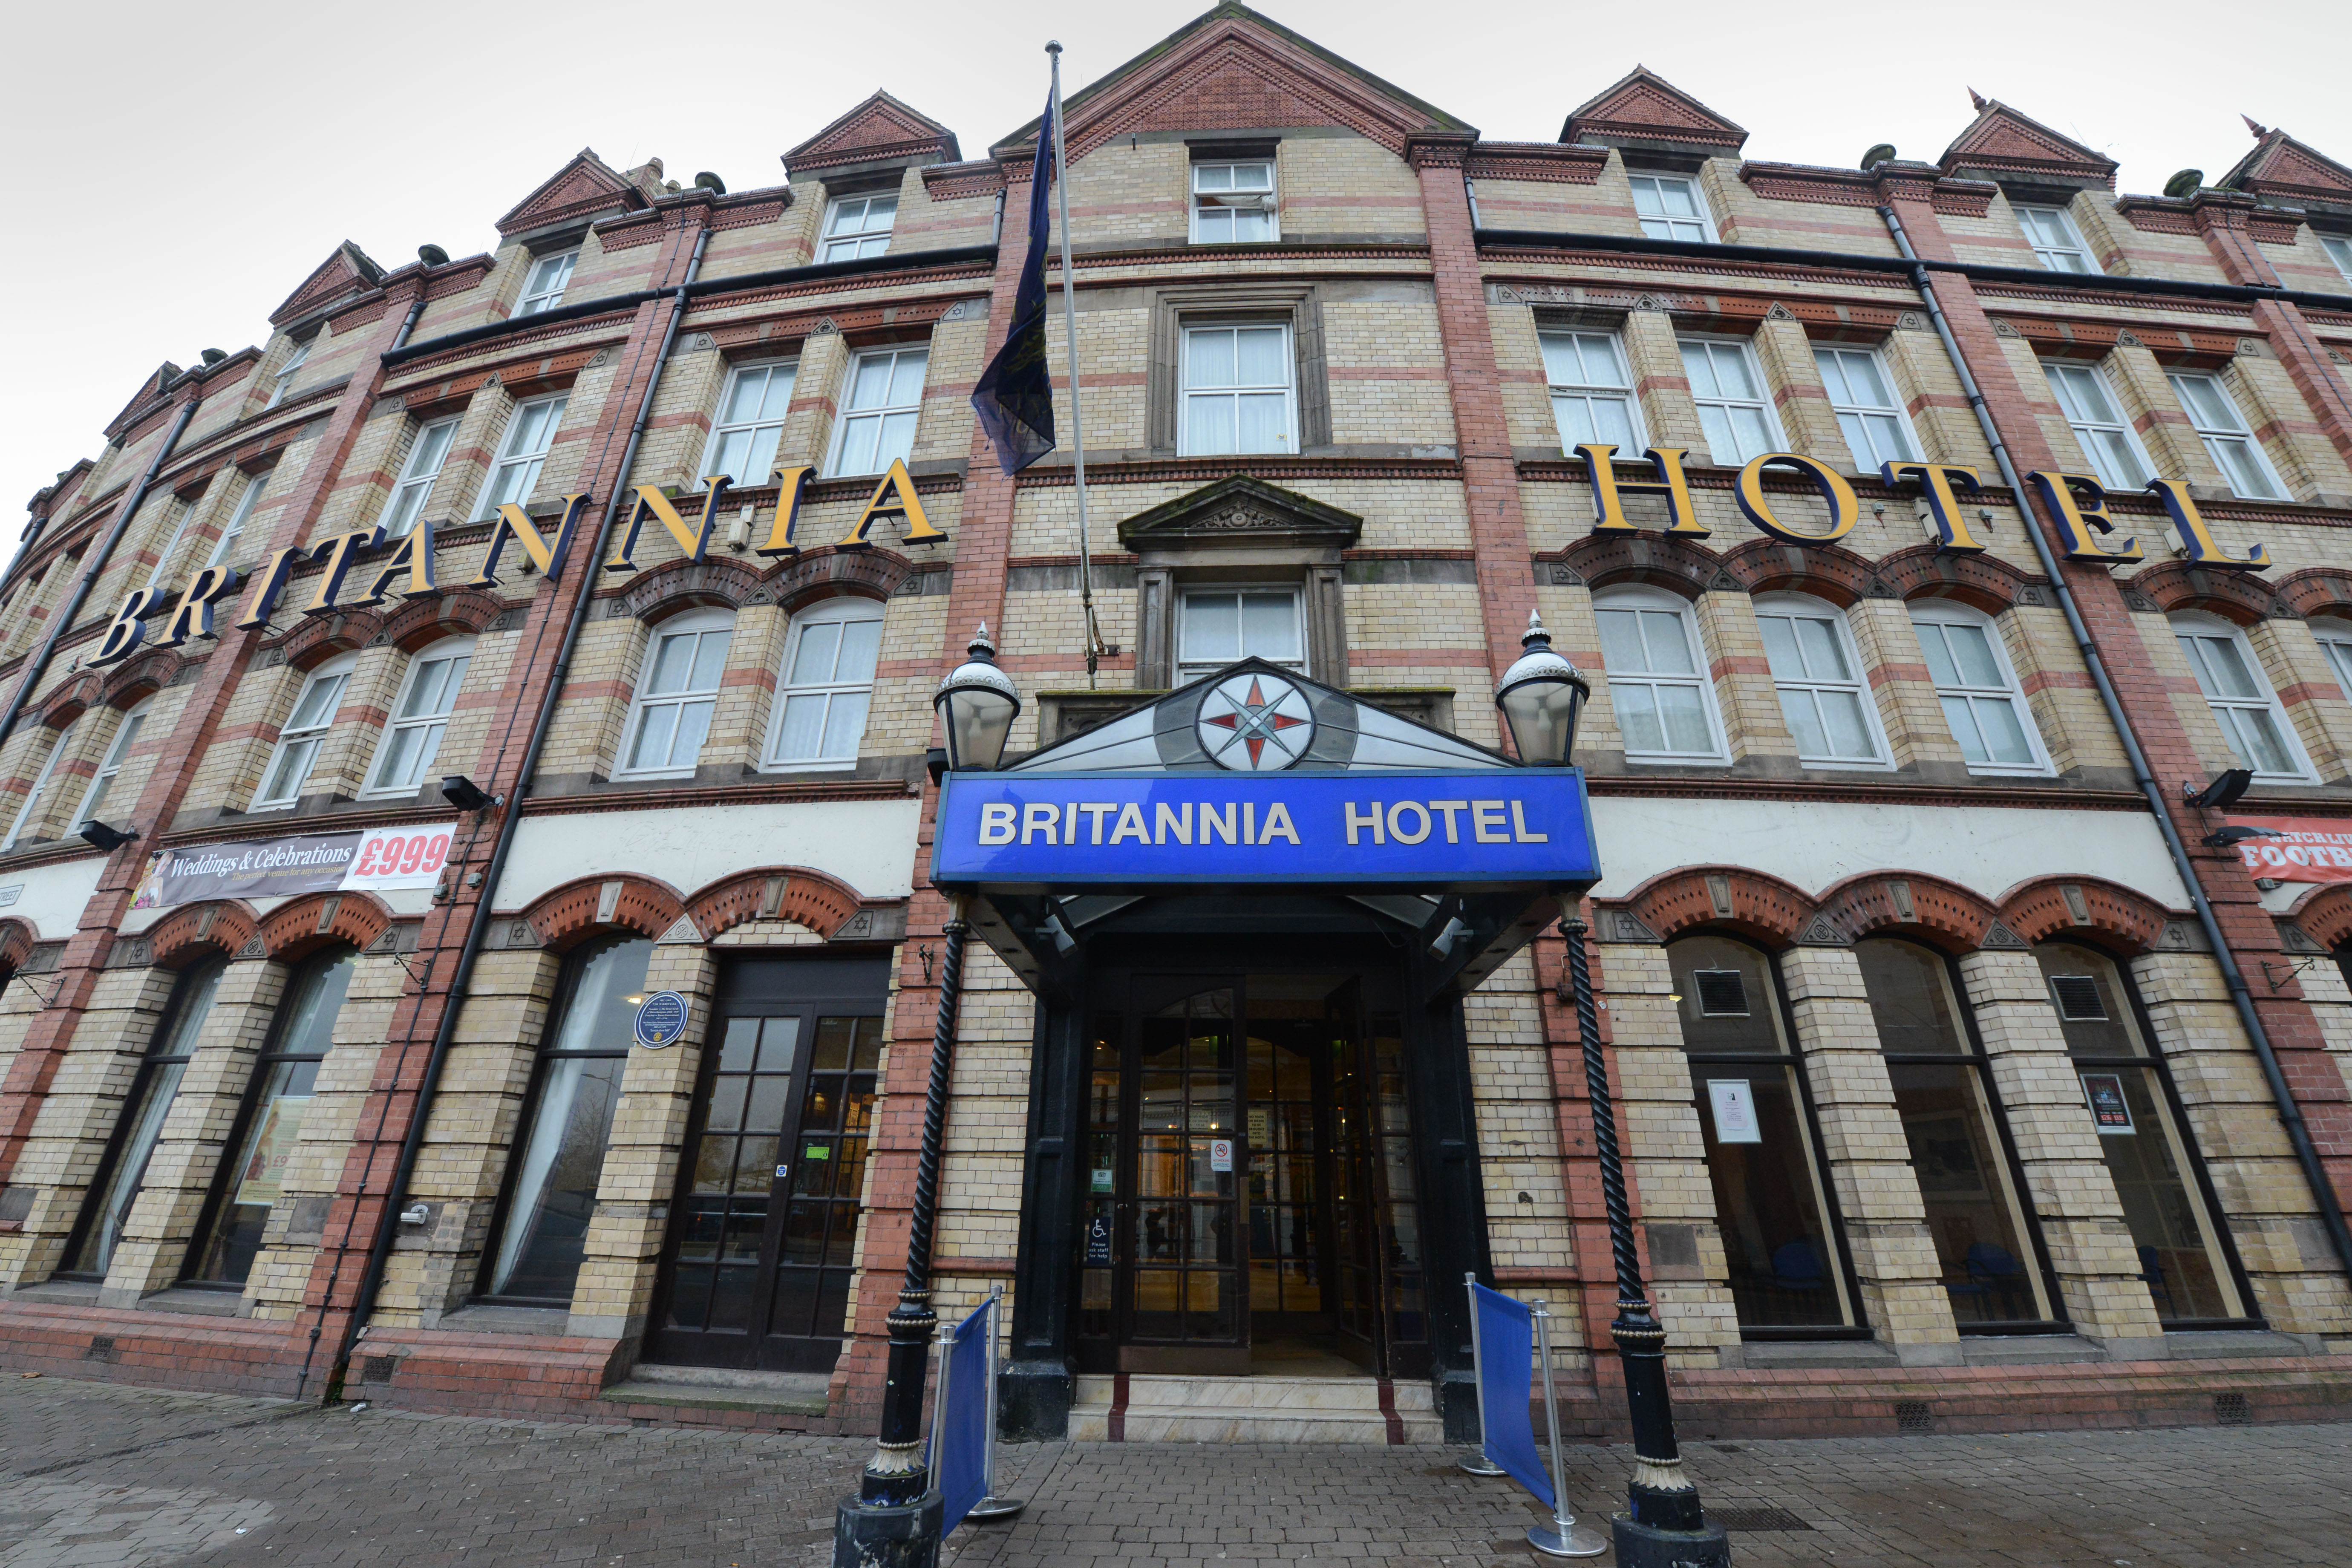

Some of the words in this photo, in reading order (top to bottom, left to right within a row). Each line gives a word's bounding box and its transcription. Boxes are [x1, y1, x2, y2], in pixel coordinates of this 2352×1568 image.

[84, 457, 948, 669] BRITANNIA
[1573, 444, 2272, 571] HOTEL
[978, 803, 1300, 845] BRITANNIA
[1344, 800, 1548, 844] HOTEL
[2268, 832, 2327, 843] WATCH
[171, 853, 239, 877] Weddings
[239, 851, 253, 870] &
[254, 843, 353, 869] Celebrations
[354, 834, 450, 876] £999
[2238, 845, 2352, 867] FOOTB
[232, 872, 244, 880] The
[243, 870, 266, 881] perfect
[290, 868, 301, 876] for
[301, 868, 314, 876] any
[314, 865, 346, 874] occasion
